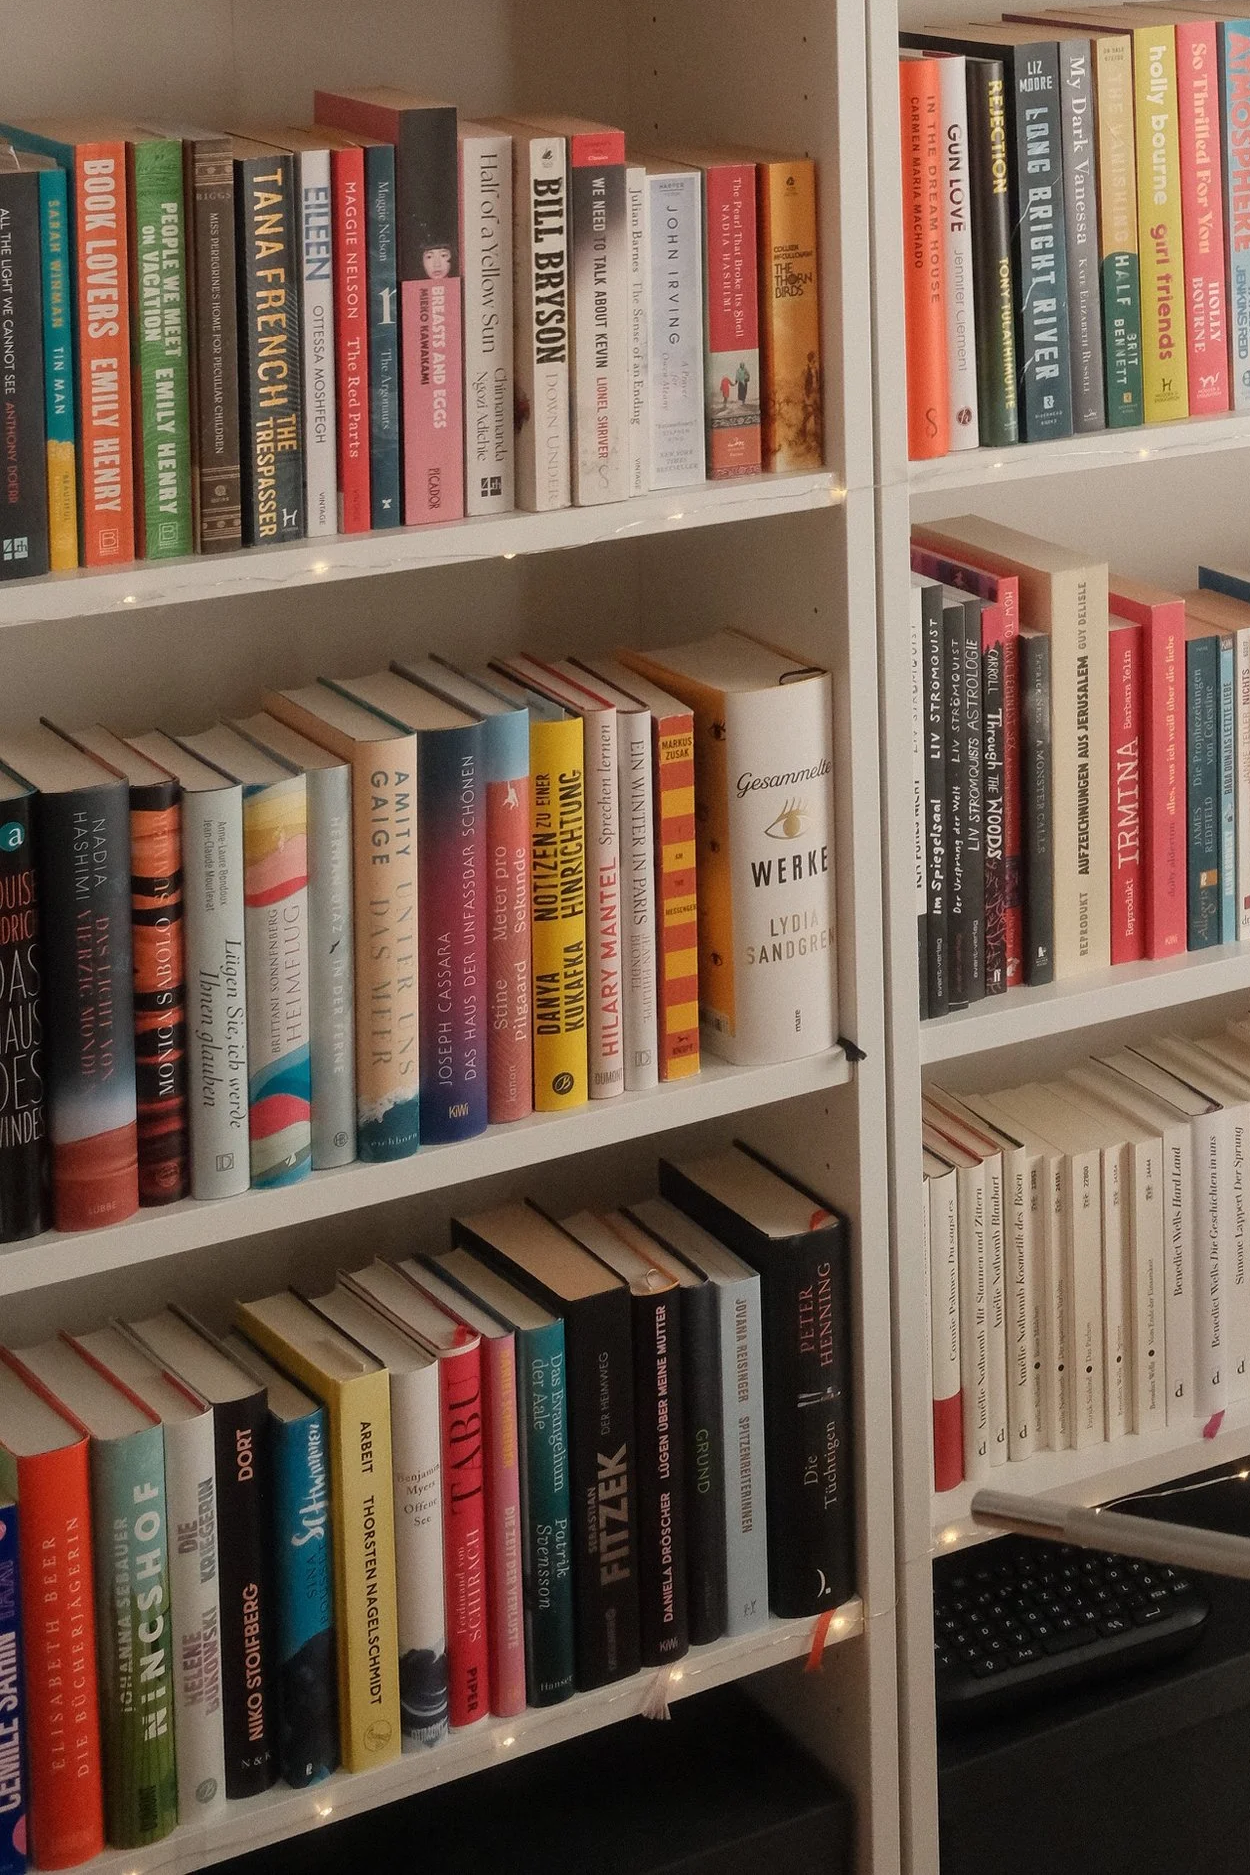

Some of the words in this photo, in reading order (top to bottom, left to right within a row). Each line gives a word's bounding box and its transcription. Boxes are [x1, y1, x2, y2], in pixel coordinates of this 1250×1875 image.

[1019, 76, 1053, 91] MOORE
[1028, 61, 1043, 74] LIZ
[988, 79, 1008, 194] REJECTION
[84, 159, 116, 231] BOOK
[253, 169, 283, 260] TANA
[533, 178, 563, 243] BILL
[304, 187, 330, 282] EILEEN
[667, 205, 680, 261] JOHN
[1028, 186, 1055, 291] BRIGHT
[85, 239, 118, 339] LOVERS
[534, 250, 566, 364] BRYSON
[667, 271, 680, 345] IRVING
[256, 267, 288, 413] FRENCH
[1032, 300, 1059, 382] RIVER
[90, 357, 118, 426] EMILY
[93, 437, 121, 512] HENRY
[929, 619, 941, 723] STRÖMQUIST
[661, 735, 693, 750] MARKUS
[665, 748, 689, 760] ZUSAK
[930, 733, 941, 759] LIV
[735, 759, 831, 798] Gesammelte
[1116, 737, 1139, 870] IRMINA
[371, 770, 389, 867] GAIGE
[395, 772, 411, 857] AMITY
[930, 798, 944, 892] Spiegelsaal
[751, 846, 829, 888] WERKE
[769, 915, 820, 938] LYDIA
[932, 896, 942, 915] Im
[746, 932, 834, 965] SANDGREN
[1171, 1147, 1182, 1176] Land
[1172, 1180, 1182, 1207] Hard
[1172, 1211, 1182, 1243] Wells
[1173, 1245, 1183, 1296] Benedict
[237, 1428, 252, 1482] DORT
[359, 1420, 375, 1474] ARBEIT
[448, 1375, 482, 1517] TABU
[363, 1495, 378, 1579] THORSTEN
[599, 1443, 632, 1587] FITZEK
[242, 1582, 262, 1685] STOIFBERG
[365, 1582, 383, 1705] NAGELSCHMIDT
[248, 1691, 264, 1743] NIKO
[466, 1666, 480, 1715] PIPER
[538, 1673, 574, 1693] Hanser
